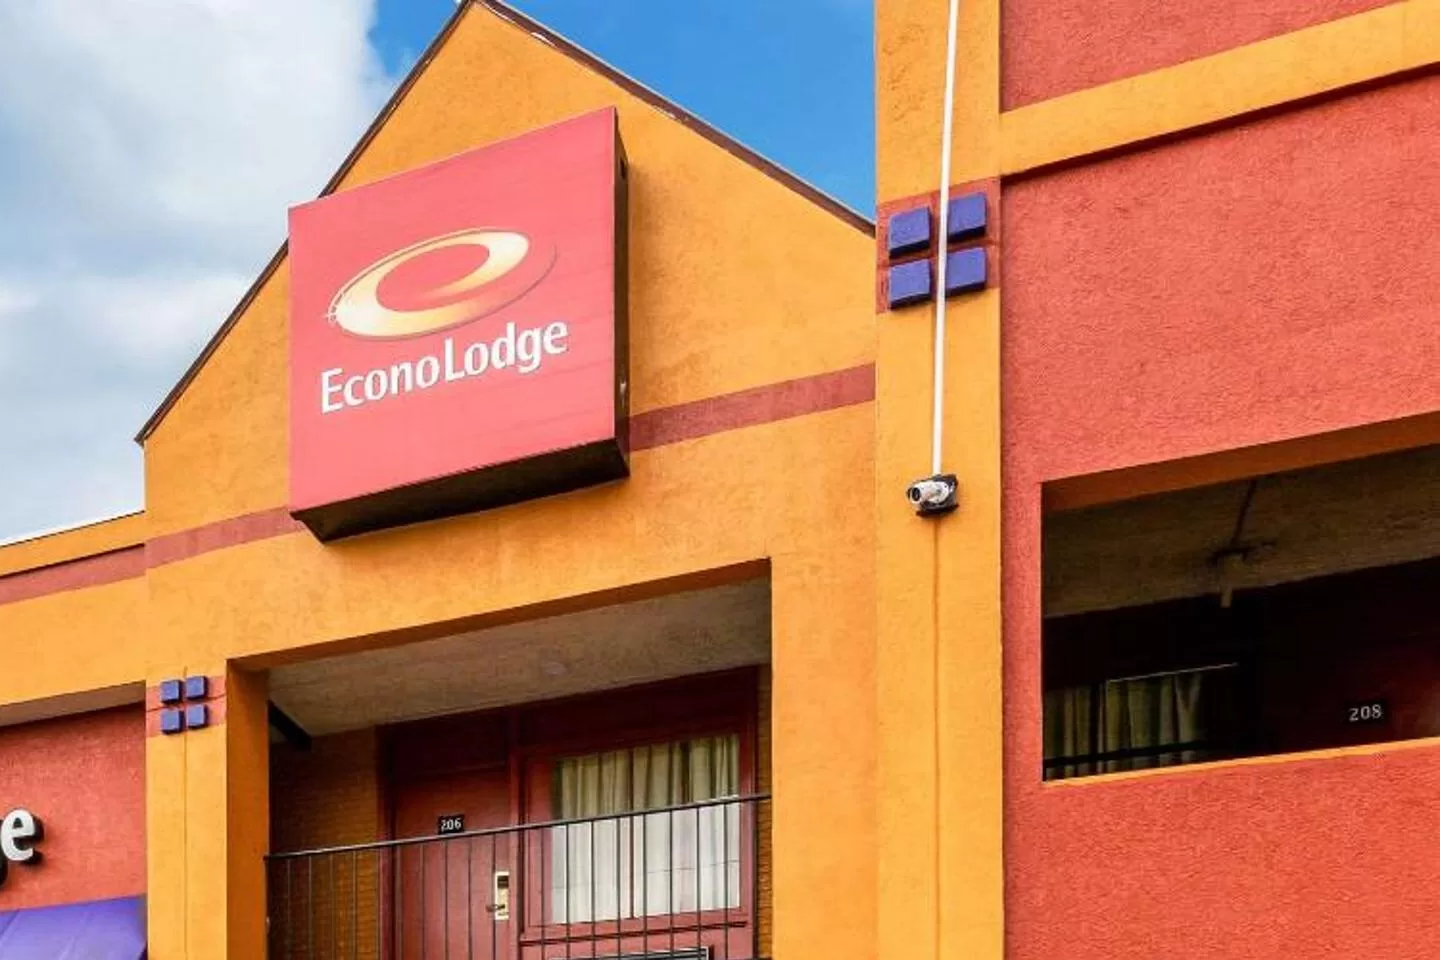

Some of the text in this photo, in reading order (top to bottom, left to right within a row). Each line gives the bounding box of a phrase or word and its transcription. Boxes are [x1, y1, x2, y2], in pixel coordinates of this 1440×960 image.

[320, 320, 569, 414] EconoLodge
[1348, 703, 1382, 722] 208
[440, 817, 462, 832] 206
